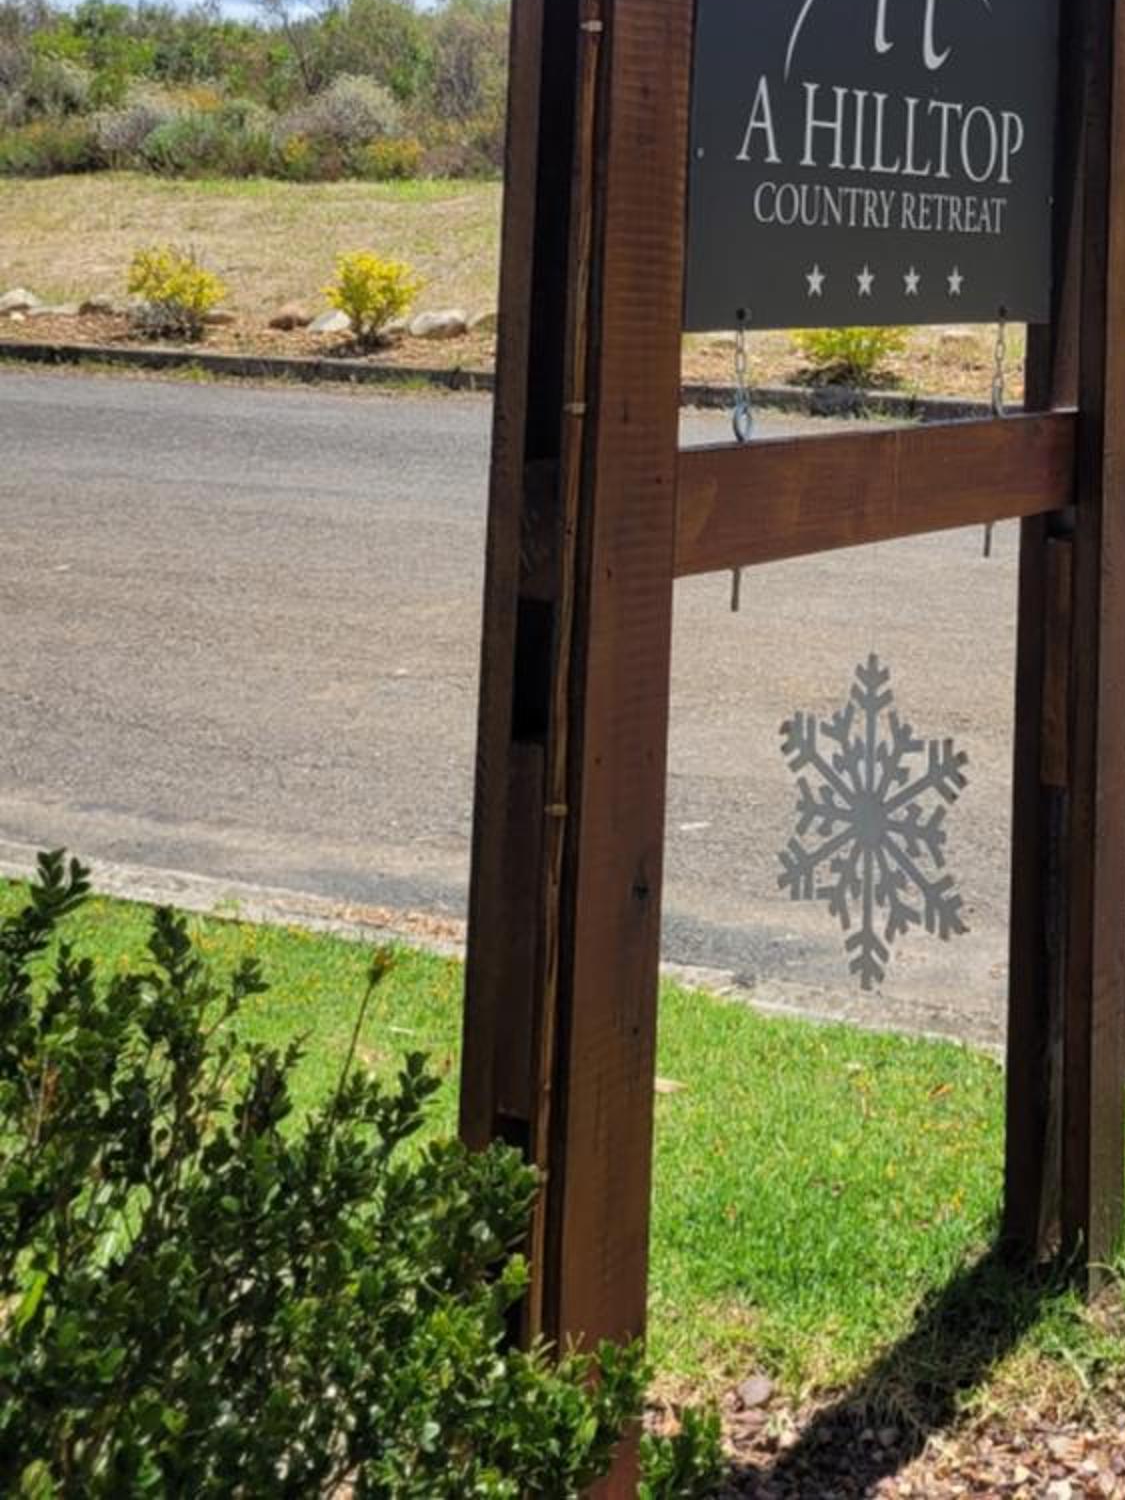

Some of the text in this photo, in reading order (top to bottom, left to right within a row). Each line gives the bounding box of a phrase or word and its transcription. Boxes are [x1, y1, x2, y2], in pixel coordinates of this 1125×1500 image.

[735, 74, 1025, 184] A HILLTOP
[753, 181, 1007, 234] COUNTRY RETREAT
